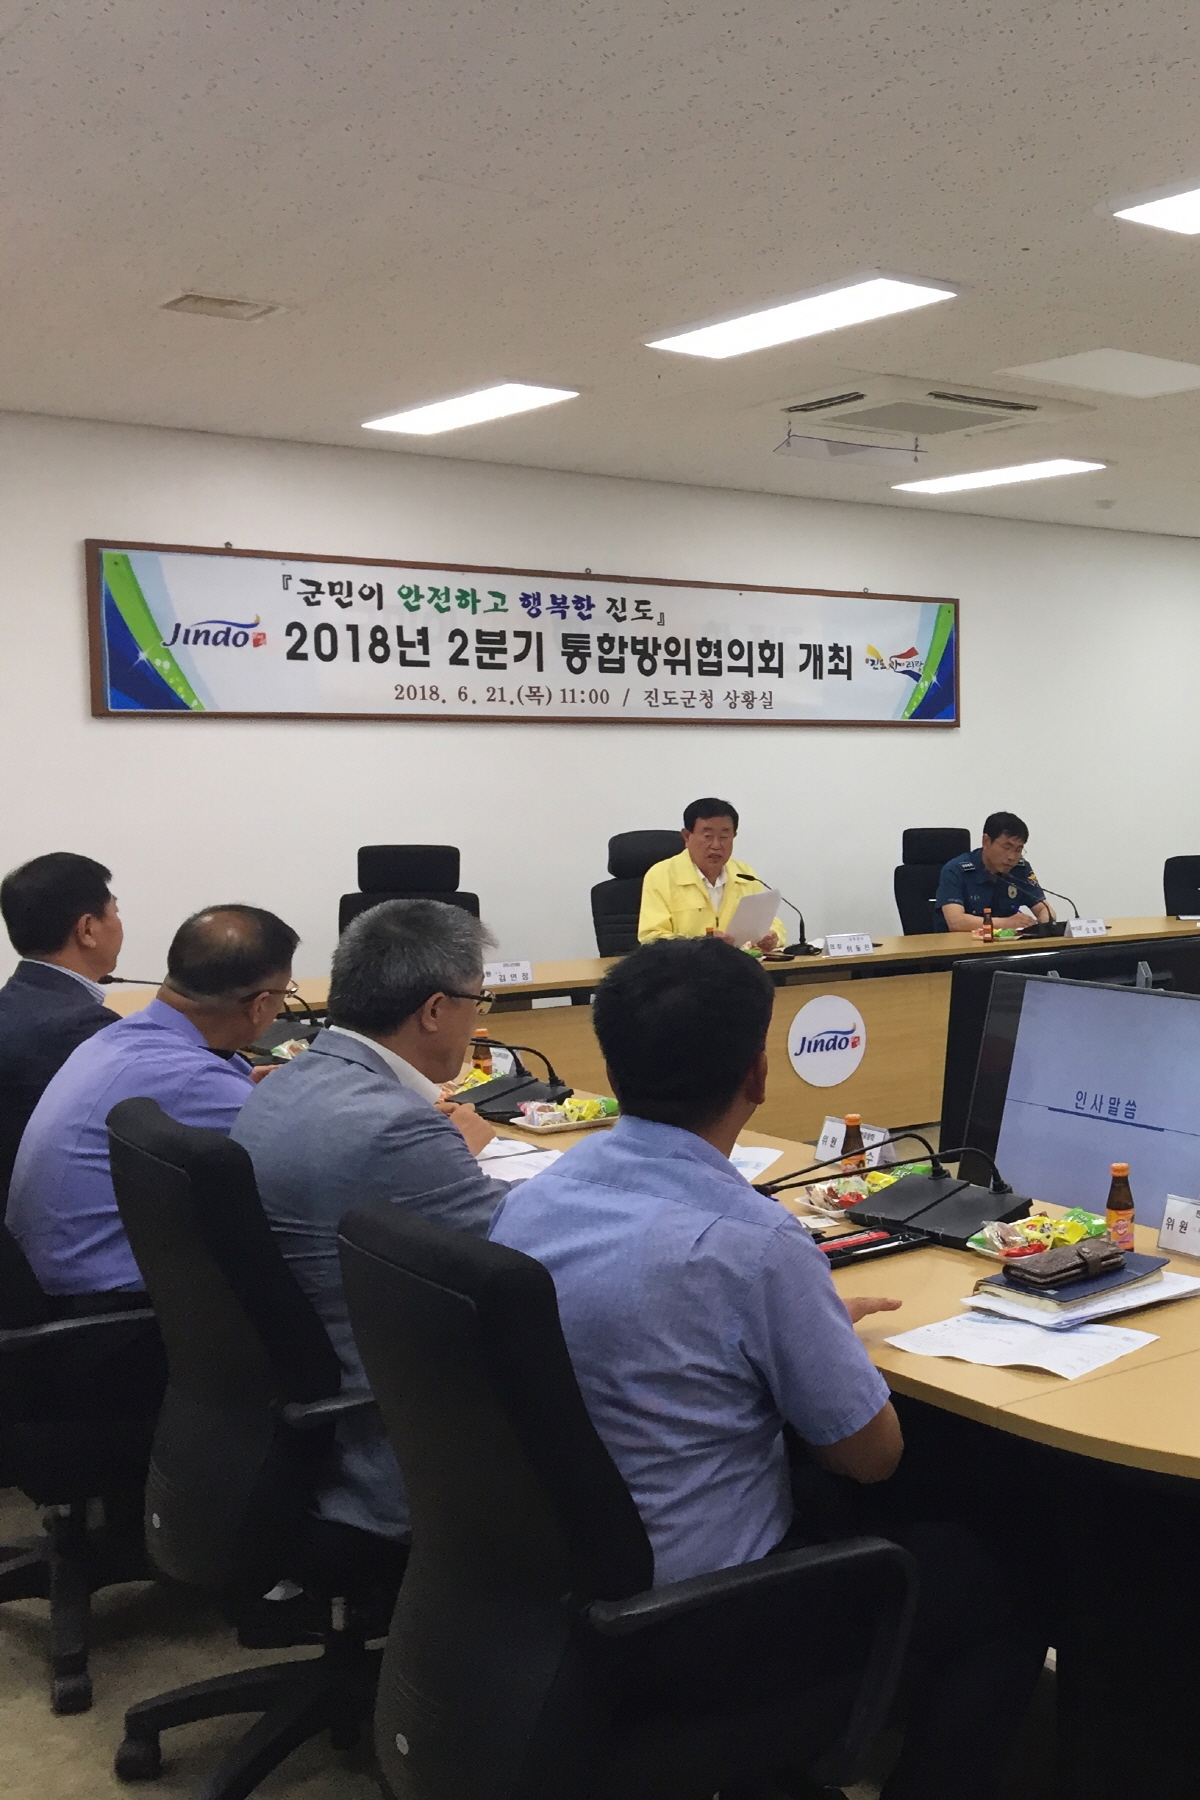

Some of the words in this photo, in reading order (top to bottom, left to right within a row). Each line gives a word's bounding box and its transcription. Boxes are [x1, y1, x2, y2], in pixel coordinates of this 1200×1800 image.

[397, 583, 509, 615] 안전하고
[519, 591, 596, 622] 행복한
[162, 622, 249, 647] Jindo
[285, 621, 430, 668] 2018년
[448, 628, 543, 672] 2분기
[560, 633, 784, 679] 통합방위협의회
[799, 643, 852, 681] 개최
[395, 684, 446, 704] 2018.
[458, 685, 477, 704] 6.
[560, 688, 610, 705] 11:00
[643, 688, 715, 709] 진도군청
[723, 689, 774, 710] 상황실
[794, 1035, 849, 1057] Jindo
[1075, 1090, 1137, 1120] 인사말씀
[1165, 1216, 1188, 1234] 위원
